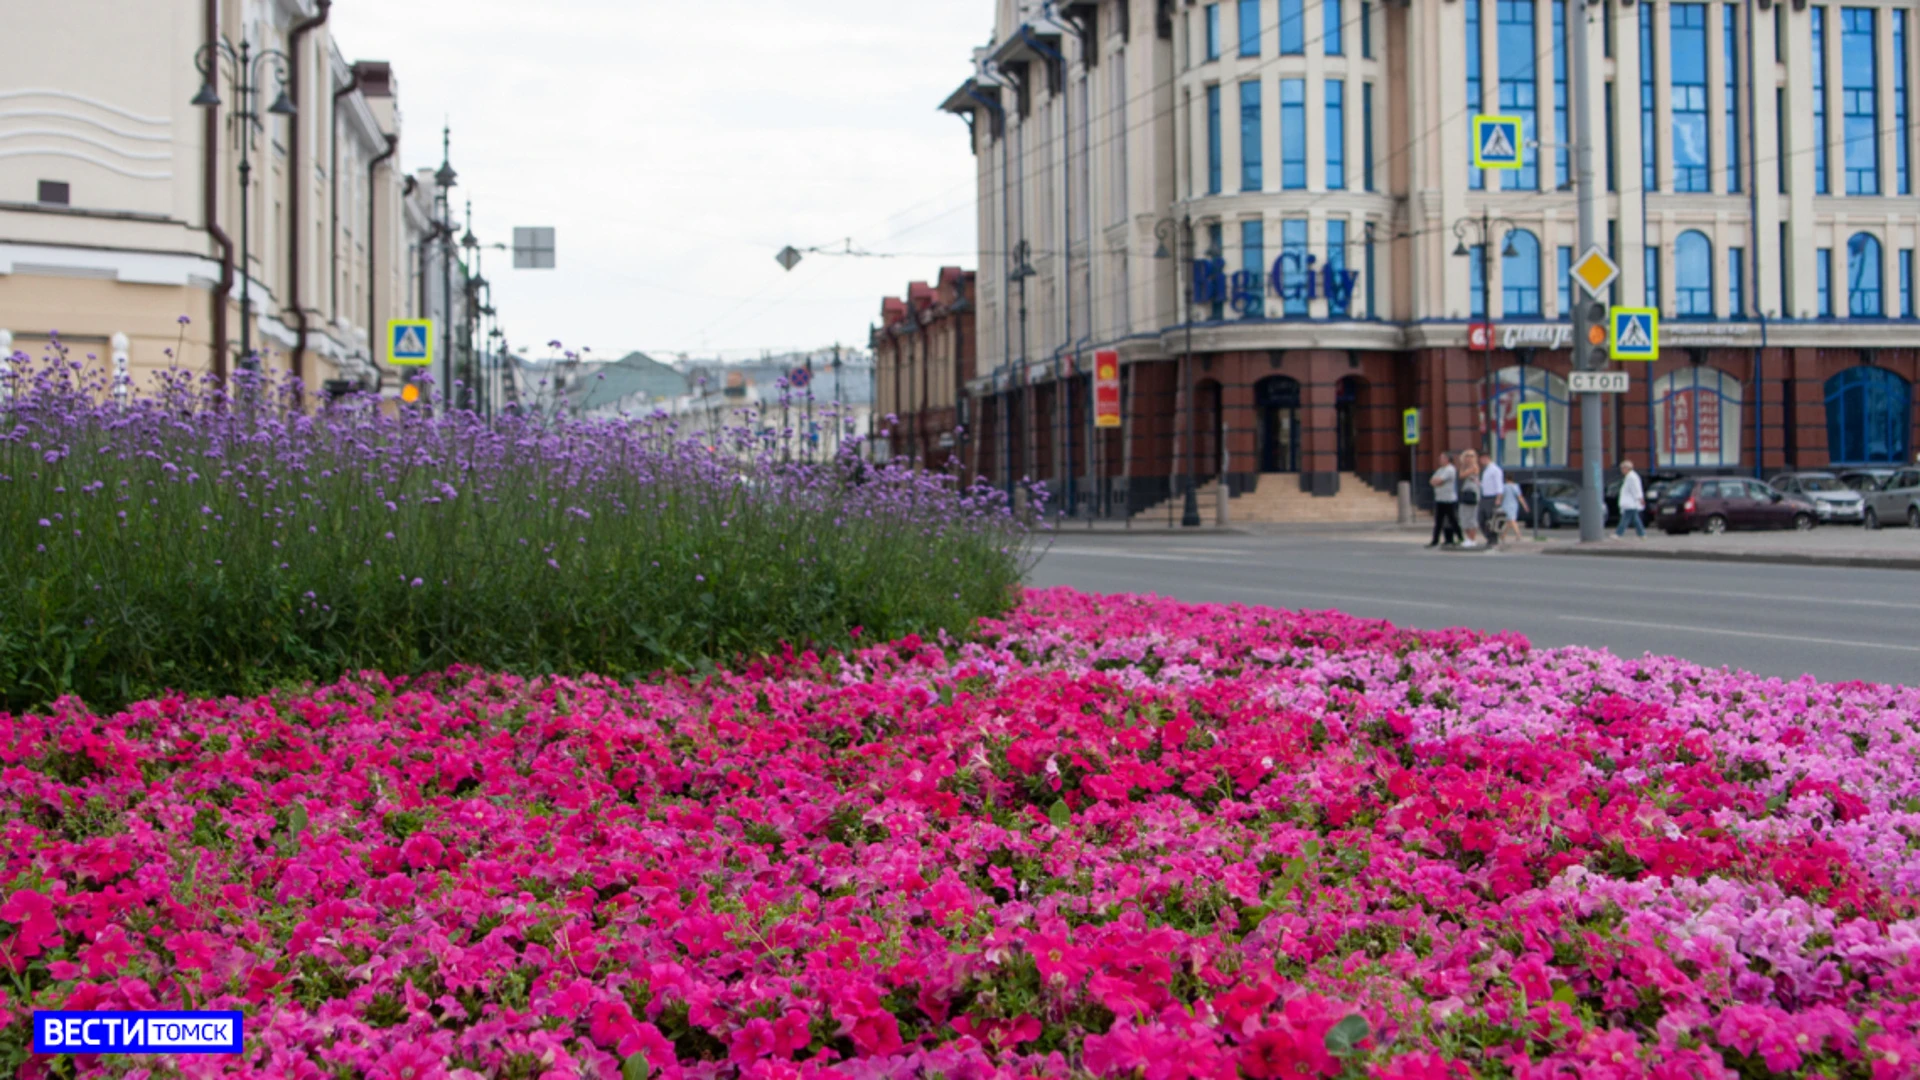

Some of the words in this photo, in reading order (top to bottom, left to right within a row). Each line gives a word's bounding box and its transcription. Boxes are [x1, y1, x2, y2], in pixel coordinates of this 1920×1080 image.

[1193, 256, 1262, 313] Big
[1272, 253, 1359, 309] City
[1573, 377, 1624, 388] СТОП
